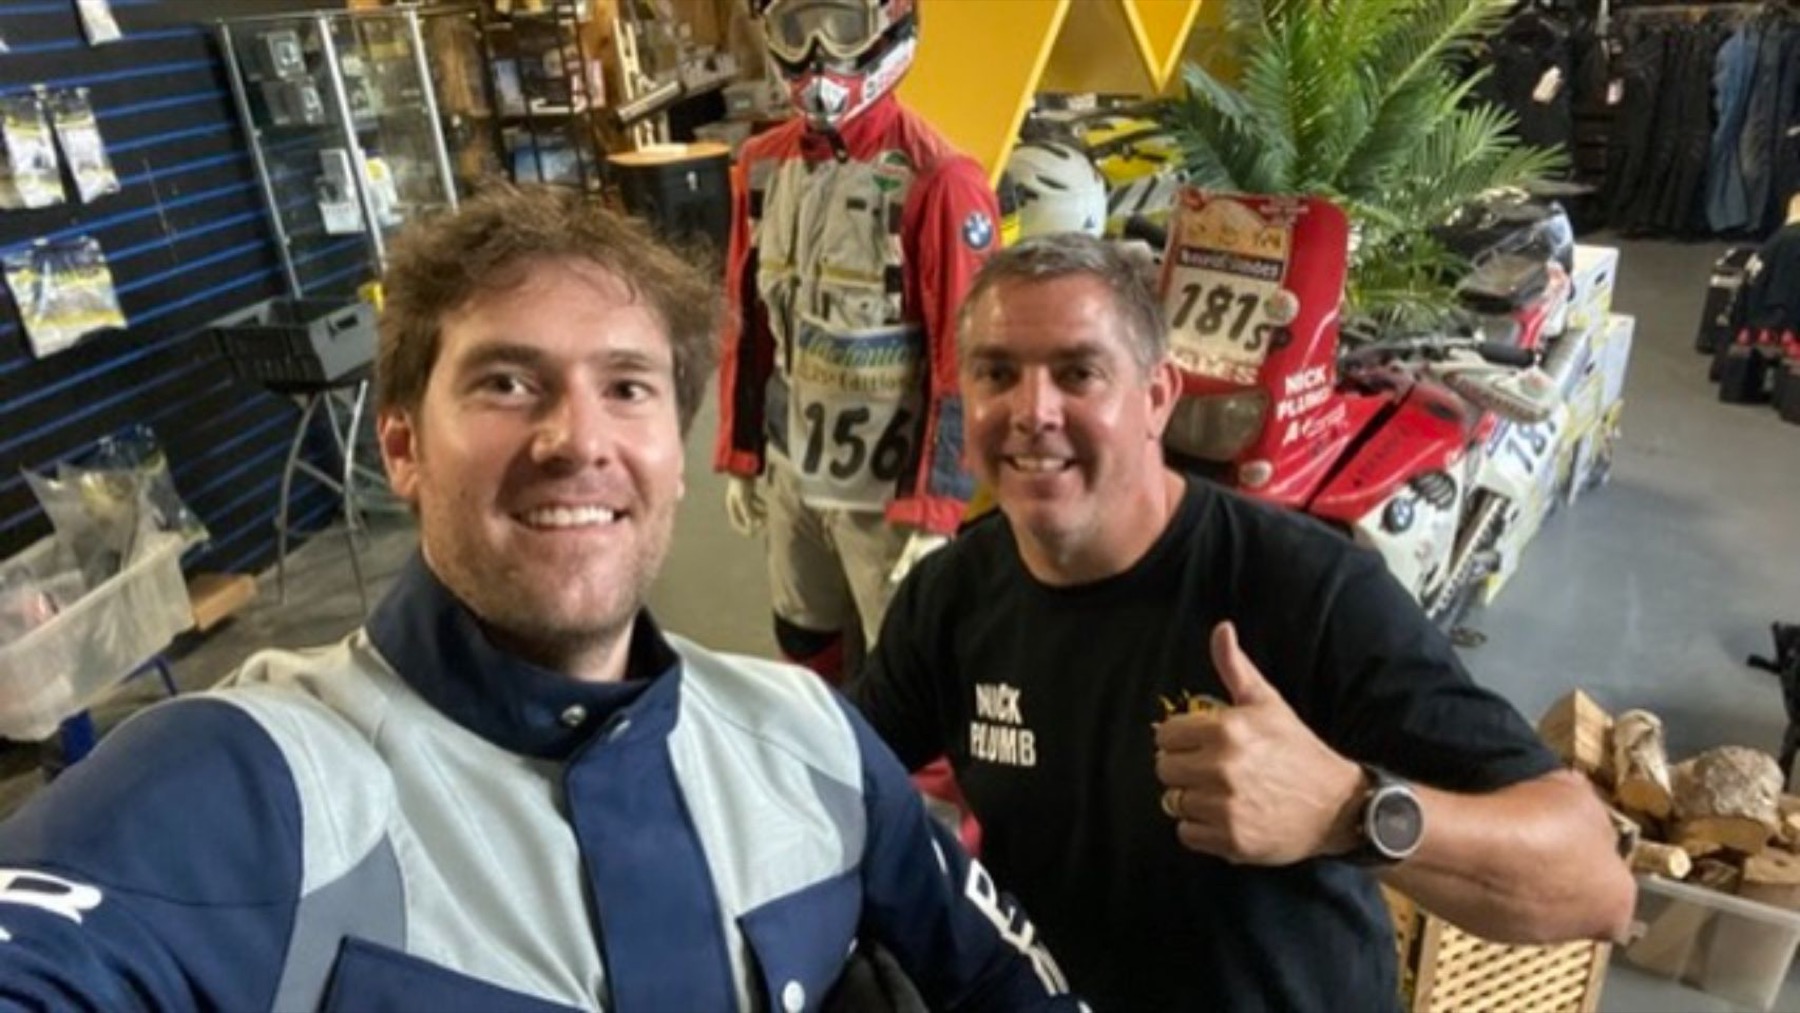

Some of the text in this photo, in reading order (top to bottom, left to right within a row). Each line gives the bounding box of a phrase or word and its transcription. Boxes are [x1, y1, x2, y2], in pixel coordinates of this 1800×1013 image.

[1284, 365, 1327, 397] NICK
[804, 402, 912, 481] 156
[975, 682, 1023, 725] NICK
[970, 721, 1037, 767] PLUMB
